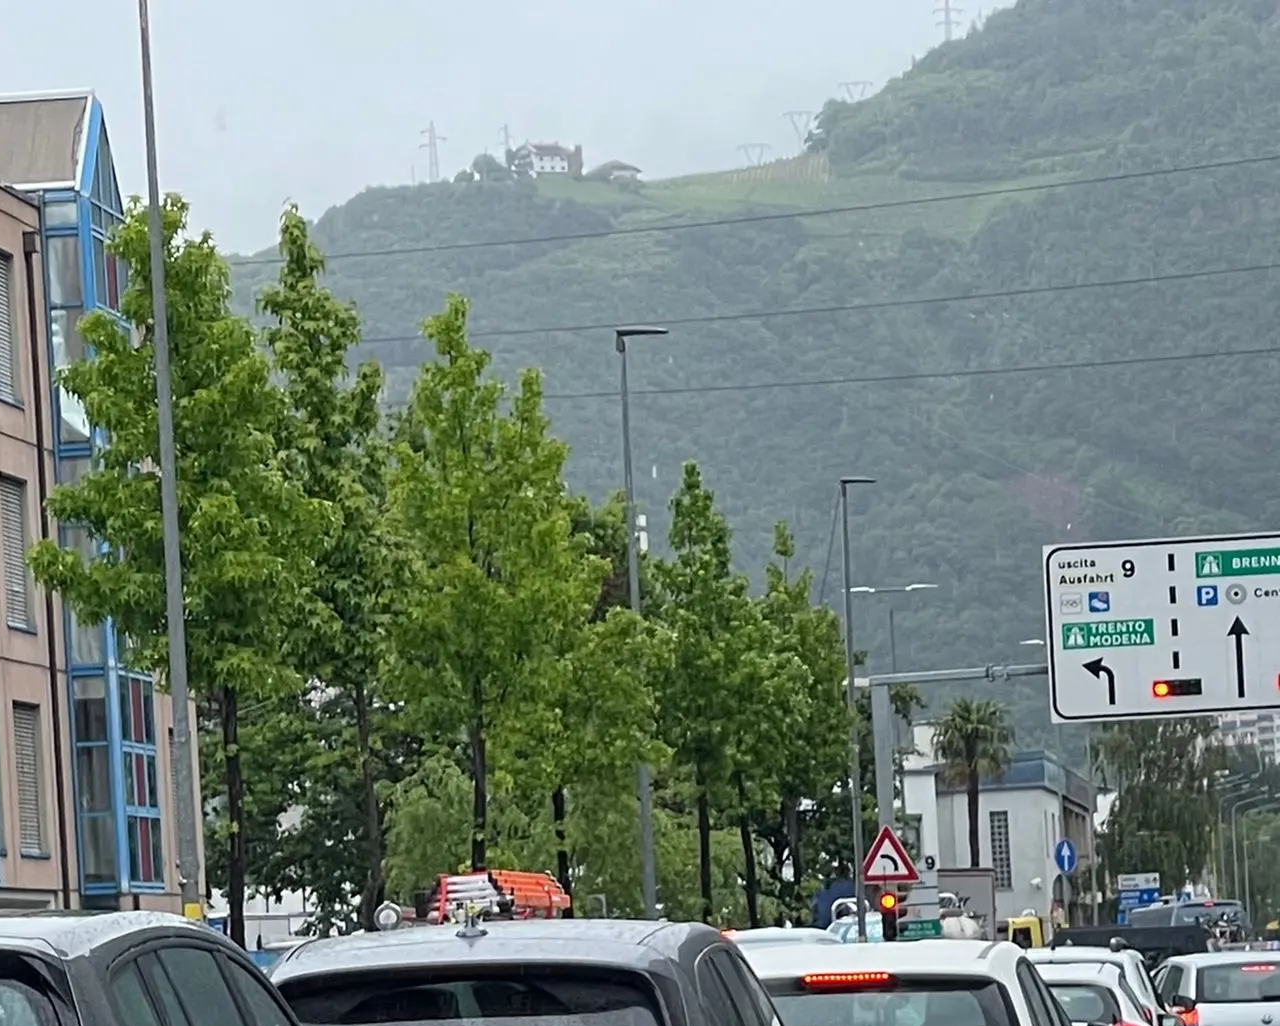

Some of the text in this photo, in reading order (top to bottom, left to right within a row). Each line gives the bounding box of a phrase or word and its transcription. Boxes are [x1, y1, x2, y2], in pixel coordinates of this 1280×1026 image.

[1058, 559, 1096, 569] uscita
[1121, 559, 1135, 578] 9
[1059, 573, 1115, 585] Ausfahrt
[1089, 621, 1145, 634] TRENTO
[1090, 633, 1151, 646] MODENA
[925, 856, 935, 870] 9
